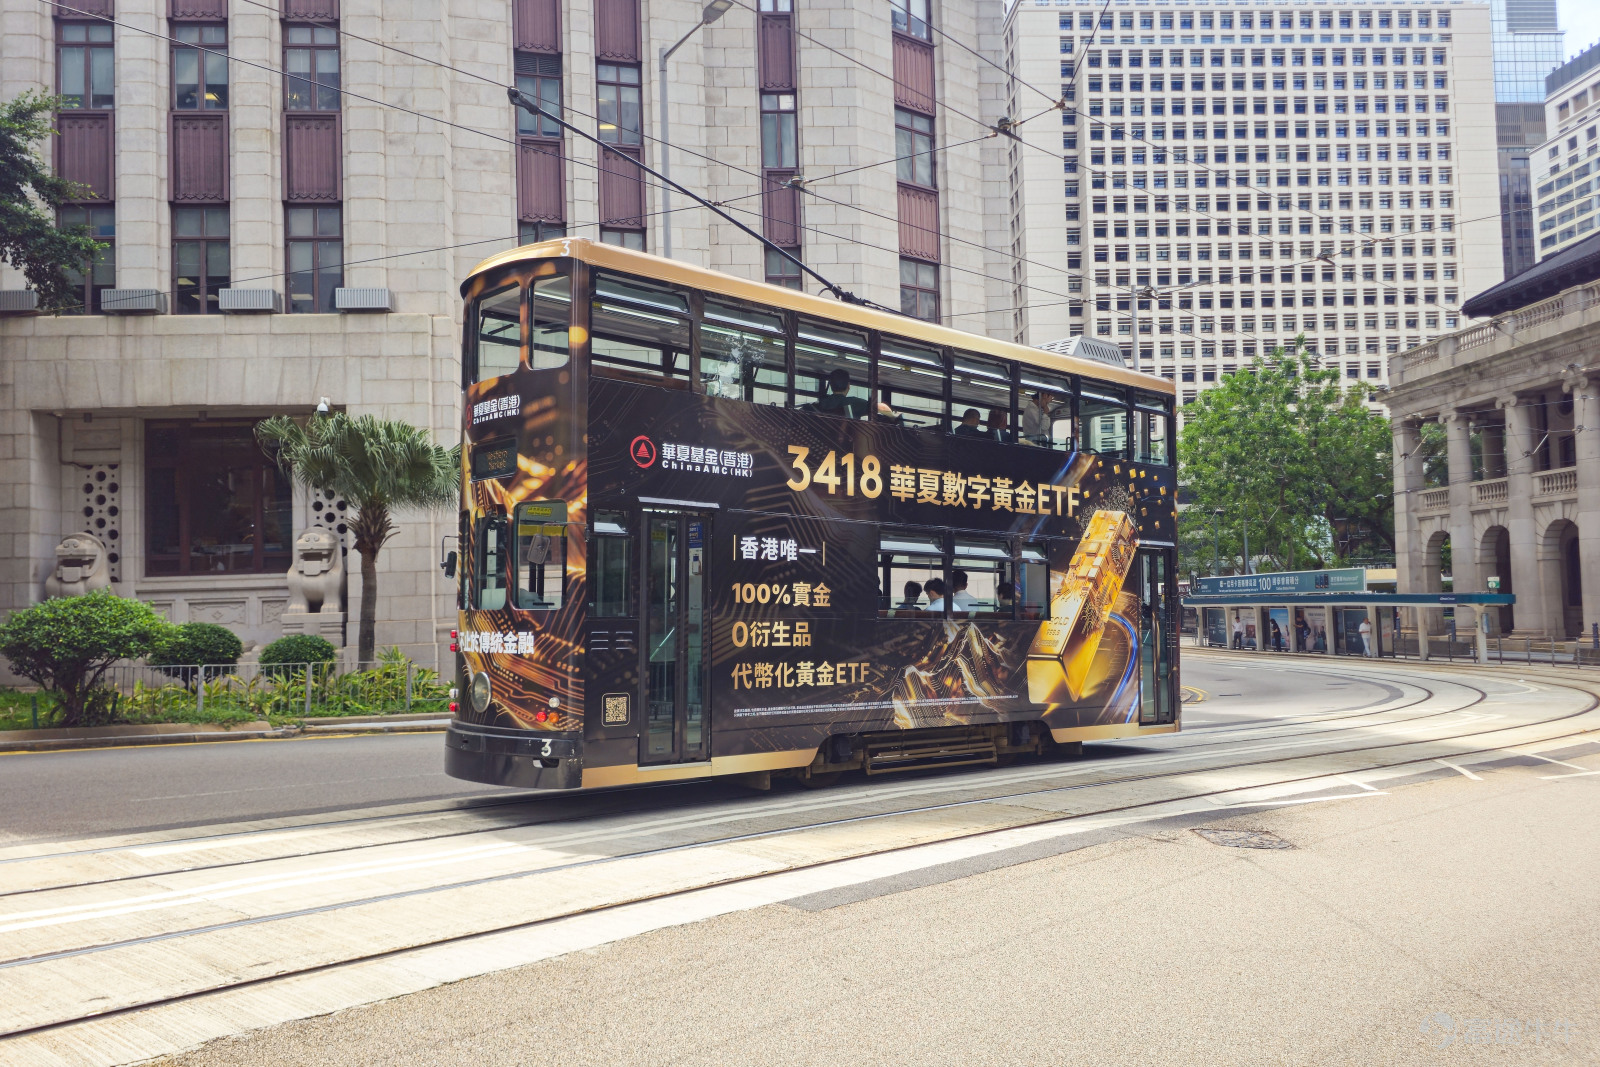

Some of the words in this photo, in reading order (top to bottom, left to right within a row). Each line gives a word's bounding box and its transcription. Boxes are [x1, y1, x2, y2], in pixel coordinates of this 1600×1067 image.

[560, 240, 572, 257] 3
[473, 394, 521, 418] 華夏基金(香港)
[661, 442, 754, 469] 華夏基金(香港)
[786, 444, 883, 499] 3418
[889, 463, 1081, 518] 華夏數字黃金ETF
[740, 536, 817, 562] 香港唯一
[731, 581, 832, 607] 100%實金
[1258, 577, 1271, 591] 100
[731, 621, 812, 647] 0衍生品
[730, 660, 871, 690] 代幣化黃金ETF
[541, 738, 552, 757] 3
